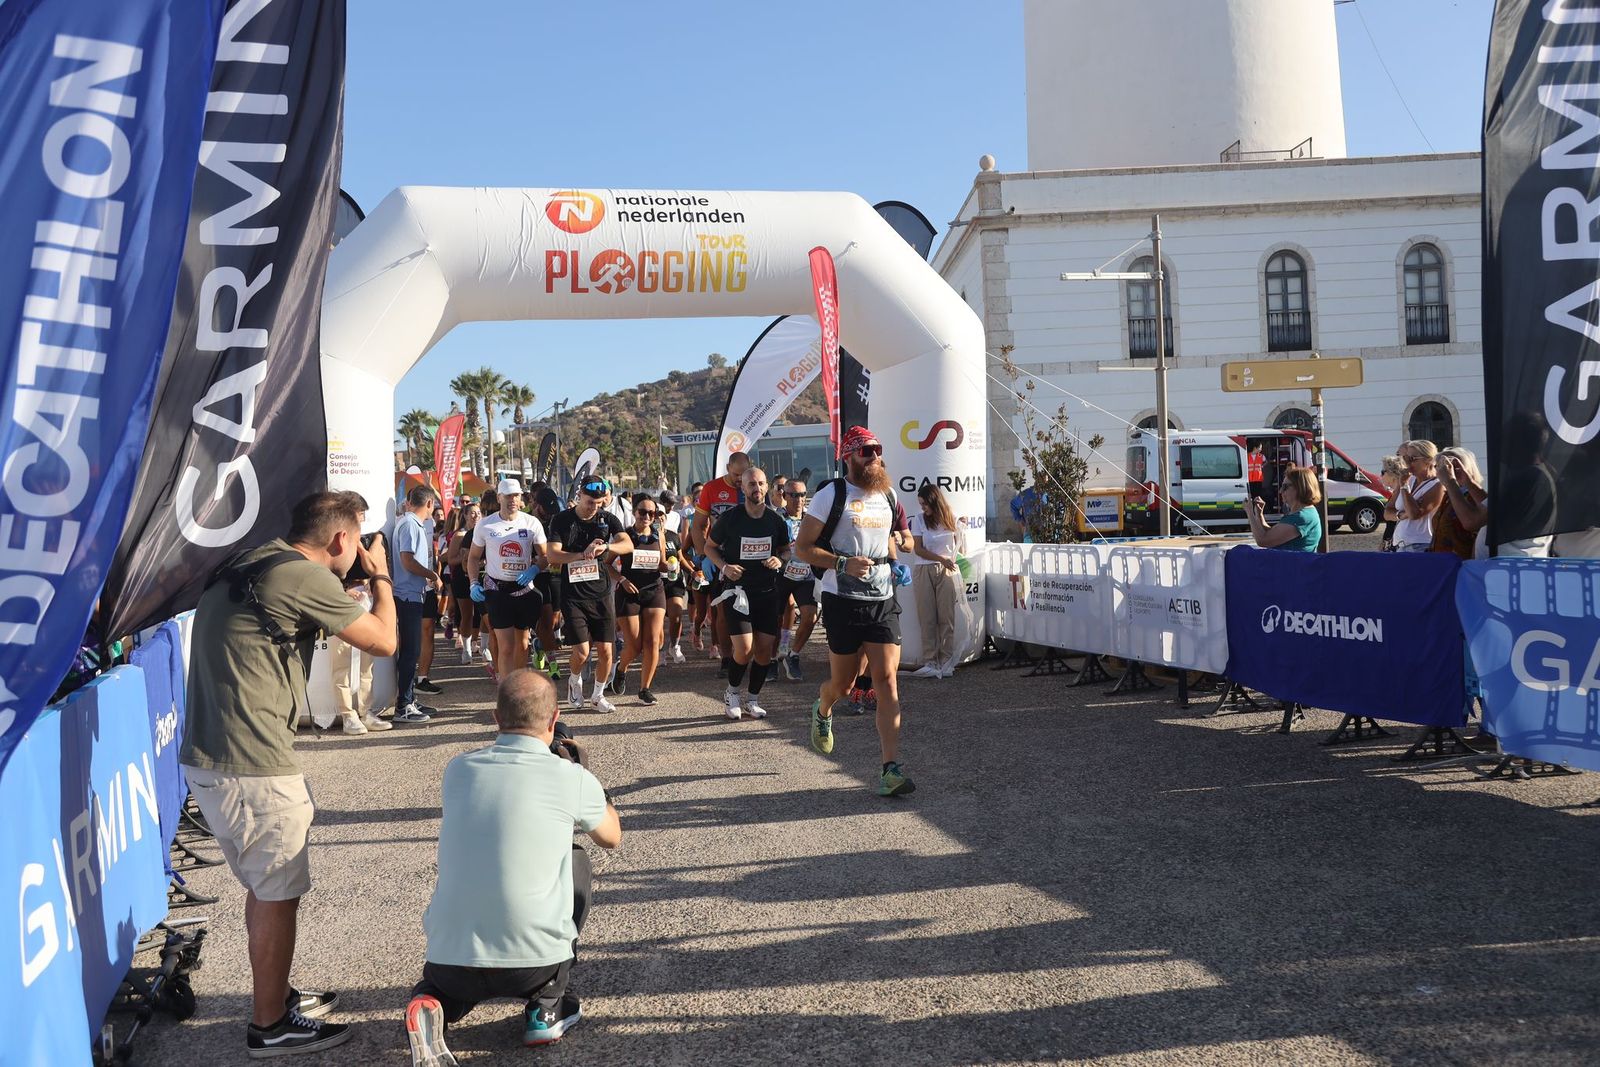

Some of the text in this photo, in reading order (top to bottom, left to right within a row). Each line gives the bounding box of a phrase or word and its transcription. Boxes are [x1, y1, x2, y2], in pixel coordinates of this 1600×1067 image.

[615, 195, 709, 207] nationale
[618, 208, 745, 224] nederlanden
[697, 233, 747, 249] TOUR
[545, 249, 748, 294] PLOGGING
[0, 34, 143, 646] DECATHLON
[739, 401, 763, 431] nationale
[744, 398, 776, 435] nederlanden
[329, 453, 358, 461] Consejo
[329, 467, 340, 475] de
[899, 475, 985, 493] GARMIN
[1030, 579, 1095, 593] Plan de Recuperación,
[1030, 590, 1074, 603] Transformación
[1035, 602, 1066, 613] Resiliencia
[1168, 597, 1202, 615] AETIB
[1284, 610, 1383, 643] DECATHLON
[18, 752, 161, 988] GARMIN
